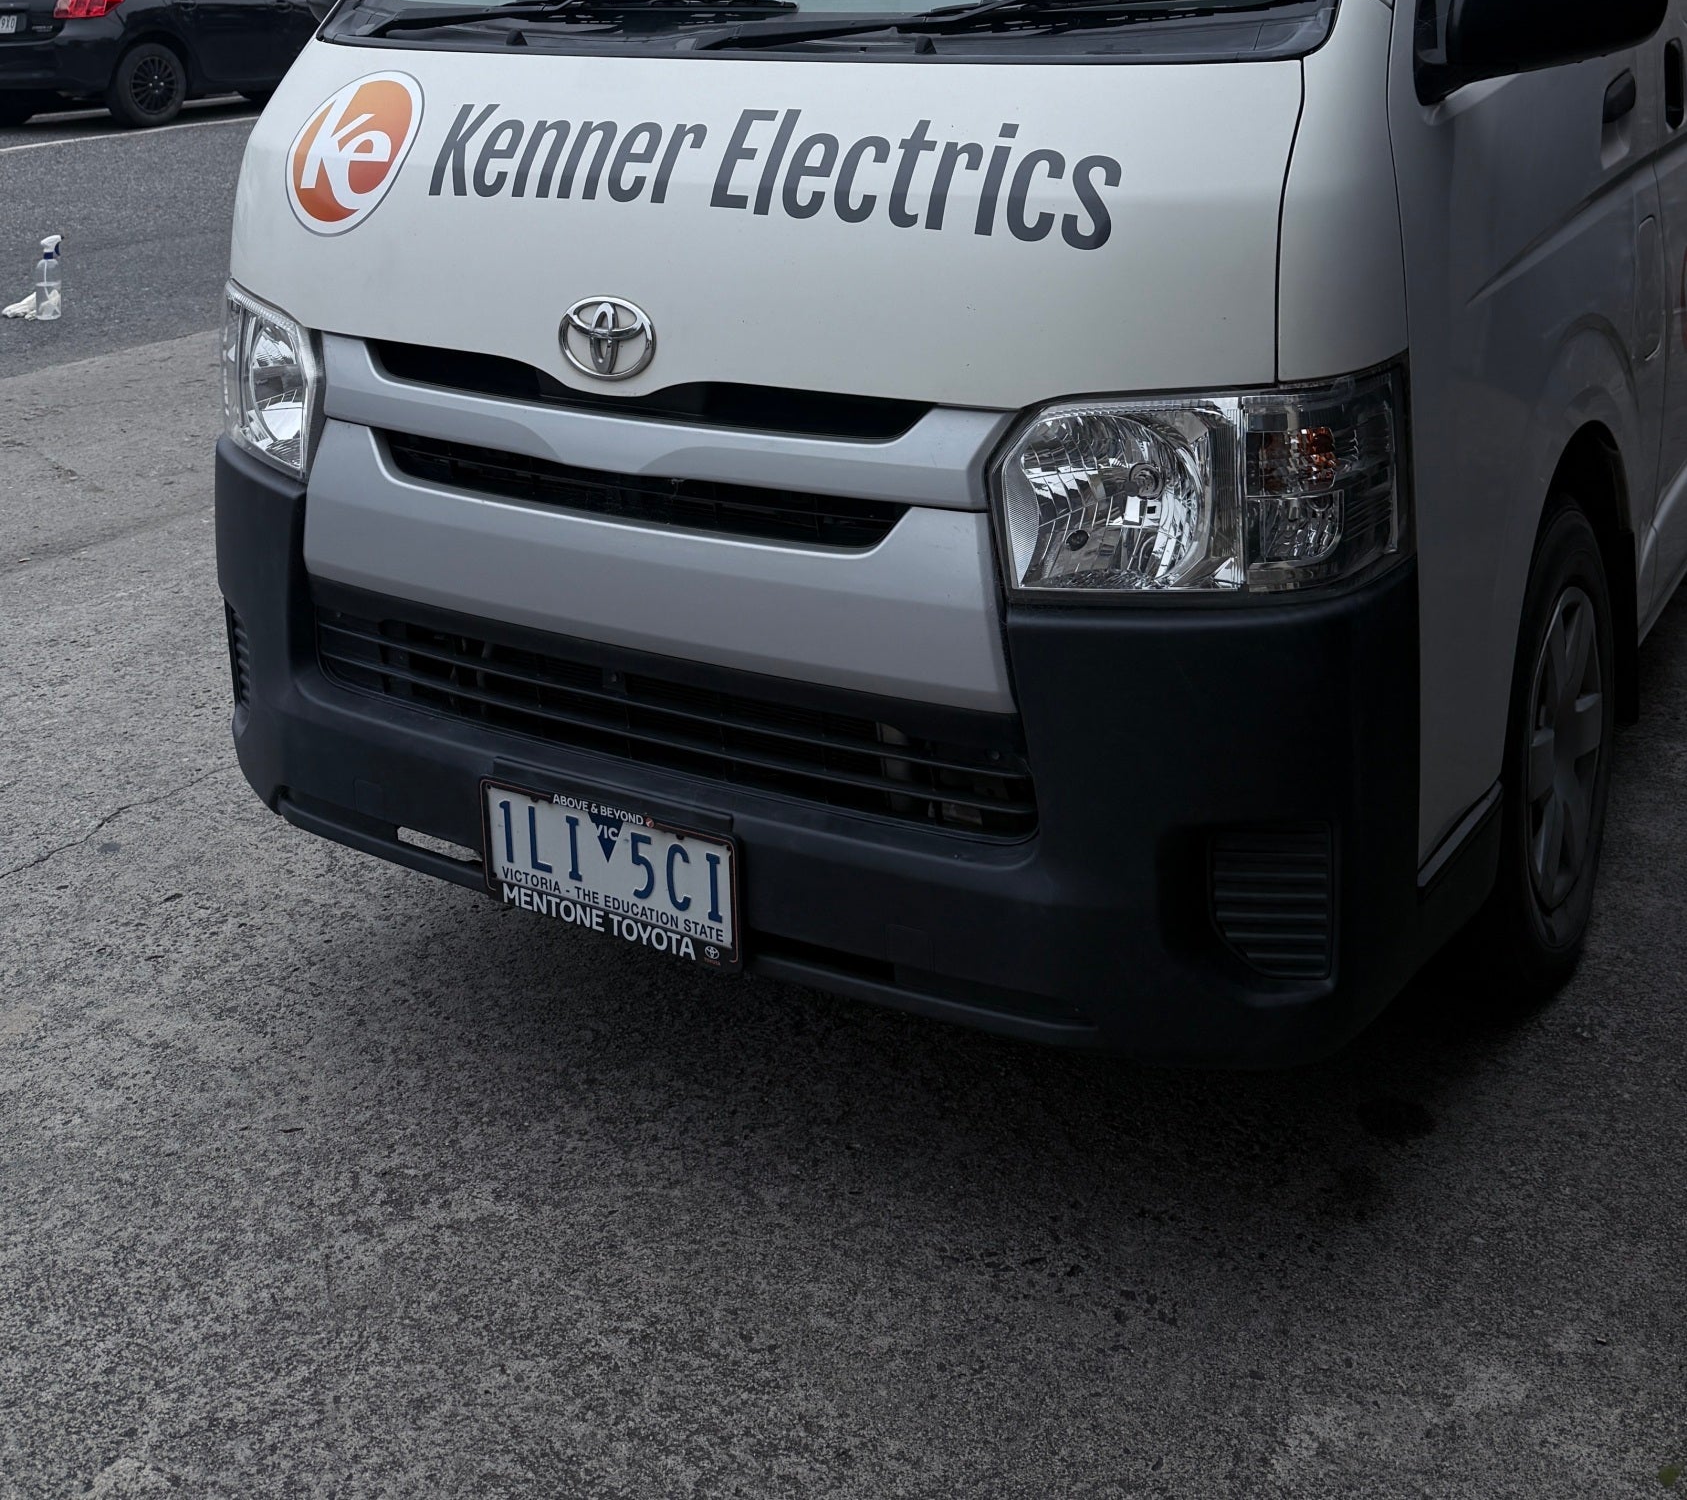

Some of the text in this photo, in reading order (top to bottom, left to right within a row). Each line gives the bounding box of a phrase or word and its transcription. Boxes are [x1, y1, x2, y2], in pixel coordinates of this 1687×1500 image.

[429, 103, 1122, 251] Kenner Electrics
[553, 794, 643, 825] ABOVE & BEYOND
[596, 824, 618, 841] VIC
[502, 866, 561, 894] VICTORIA
[574, 886, 599, 904] THE
[604, 894, 679, 929] EDUCATION
[684, 918, 724, 942] STATE
[503, 882, 696, 961] MENTONE TOYOTA
